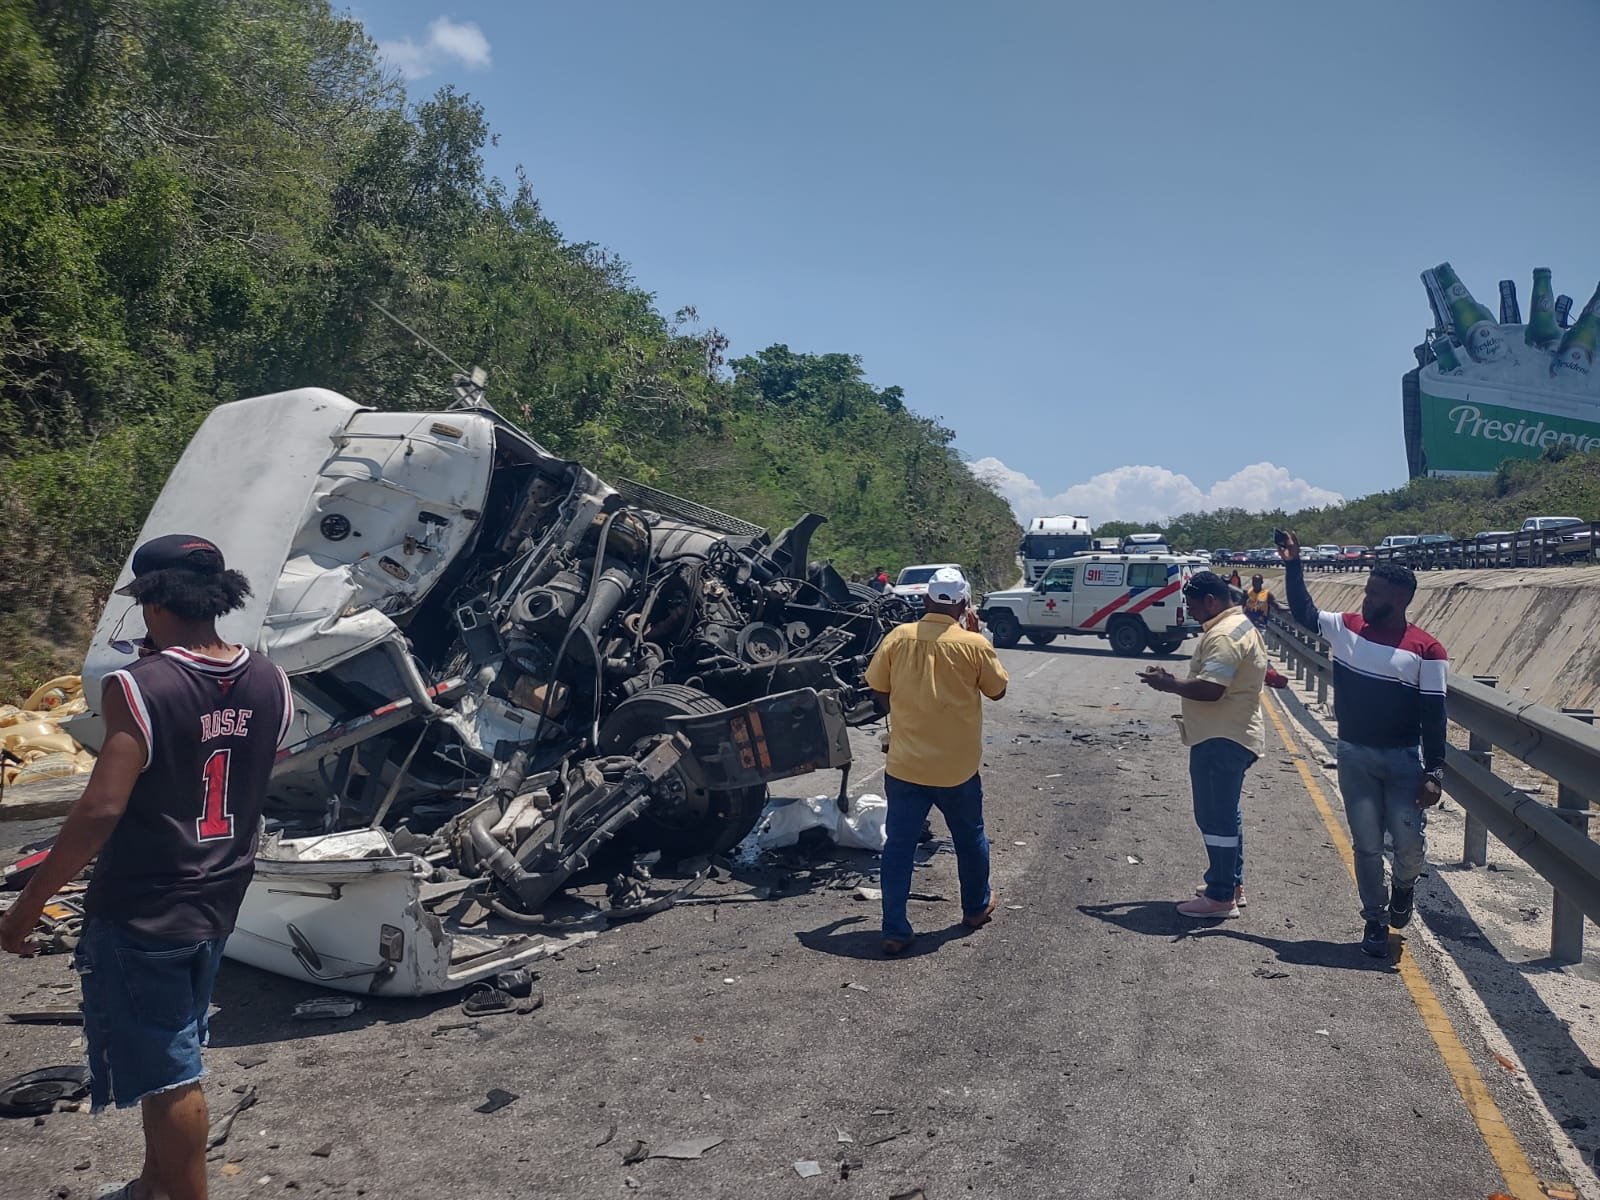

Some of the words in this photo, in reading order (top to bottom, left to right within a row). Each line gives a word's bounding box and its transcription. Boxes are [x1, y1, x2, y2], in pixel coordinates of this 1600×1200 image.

[1448, 404, 1600, 454] Presidente
[1087, 569, 1101, 581] 911
[200, 708, 253, 743] ROSE
[196, 748, 235, 843] 1
